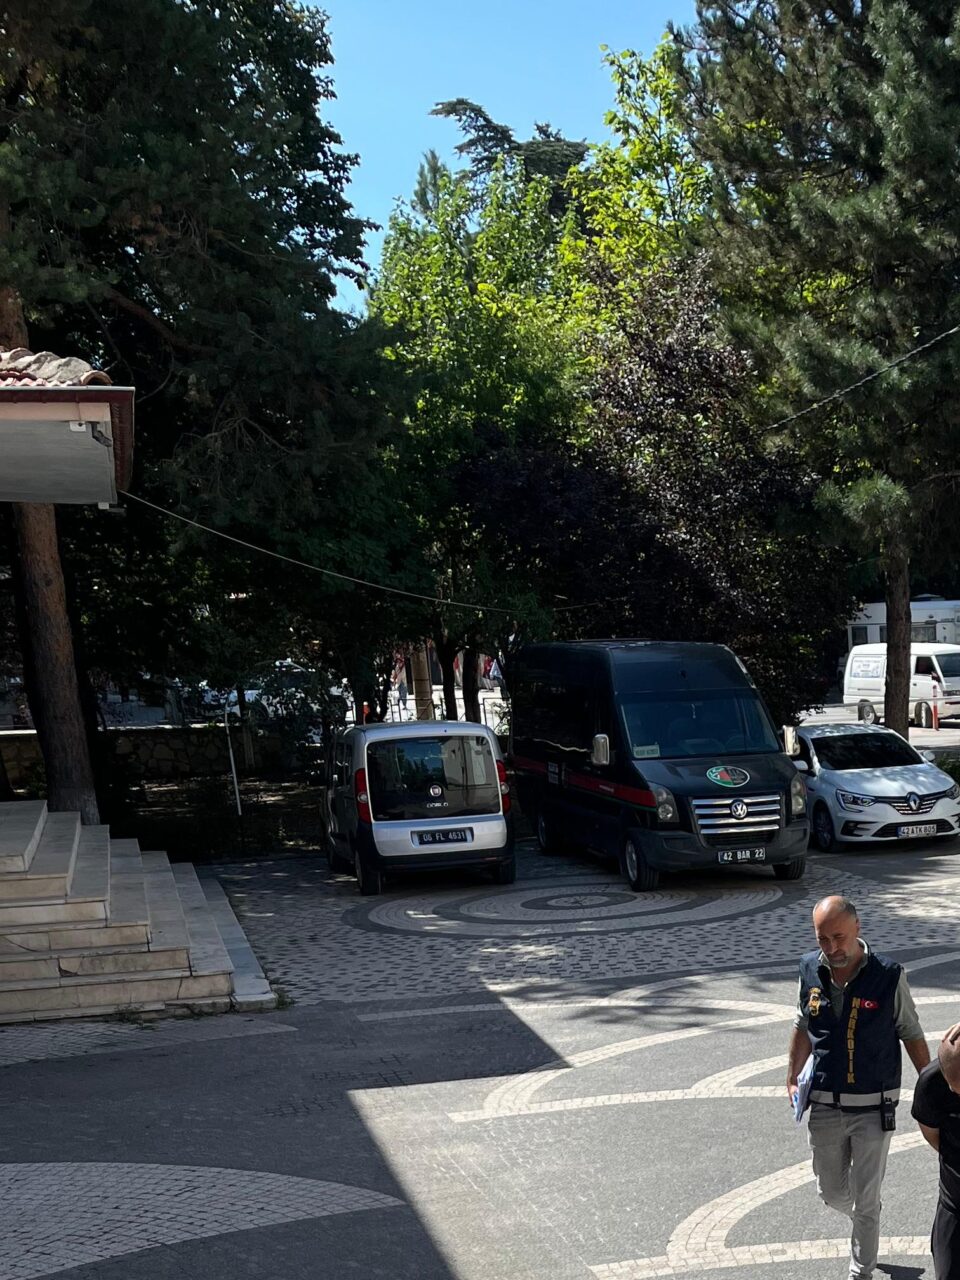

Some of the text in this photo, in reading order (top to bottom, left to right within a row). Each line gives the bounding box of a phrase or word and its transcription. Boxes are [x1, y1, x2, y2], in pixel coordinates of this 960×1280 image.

[435, 832, 446, 841] FL
[723, 851, 733, 861] 42
[754, 848, 764, 858] 22
